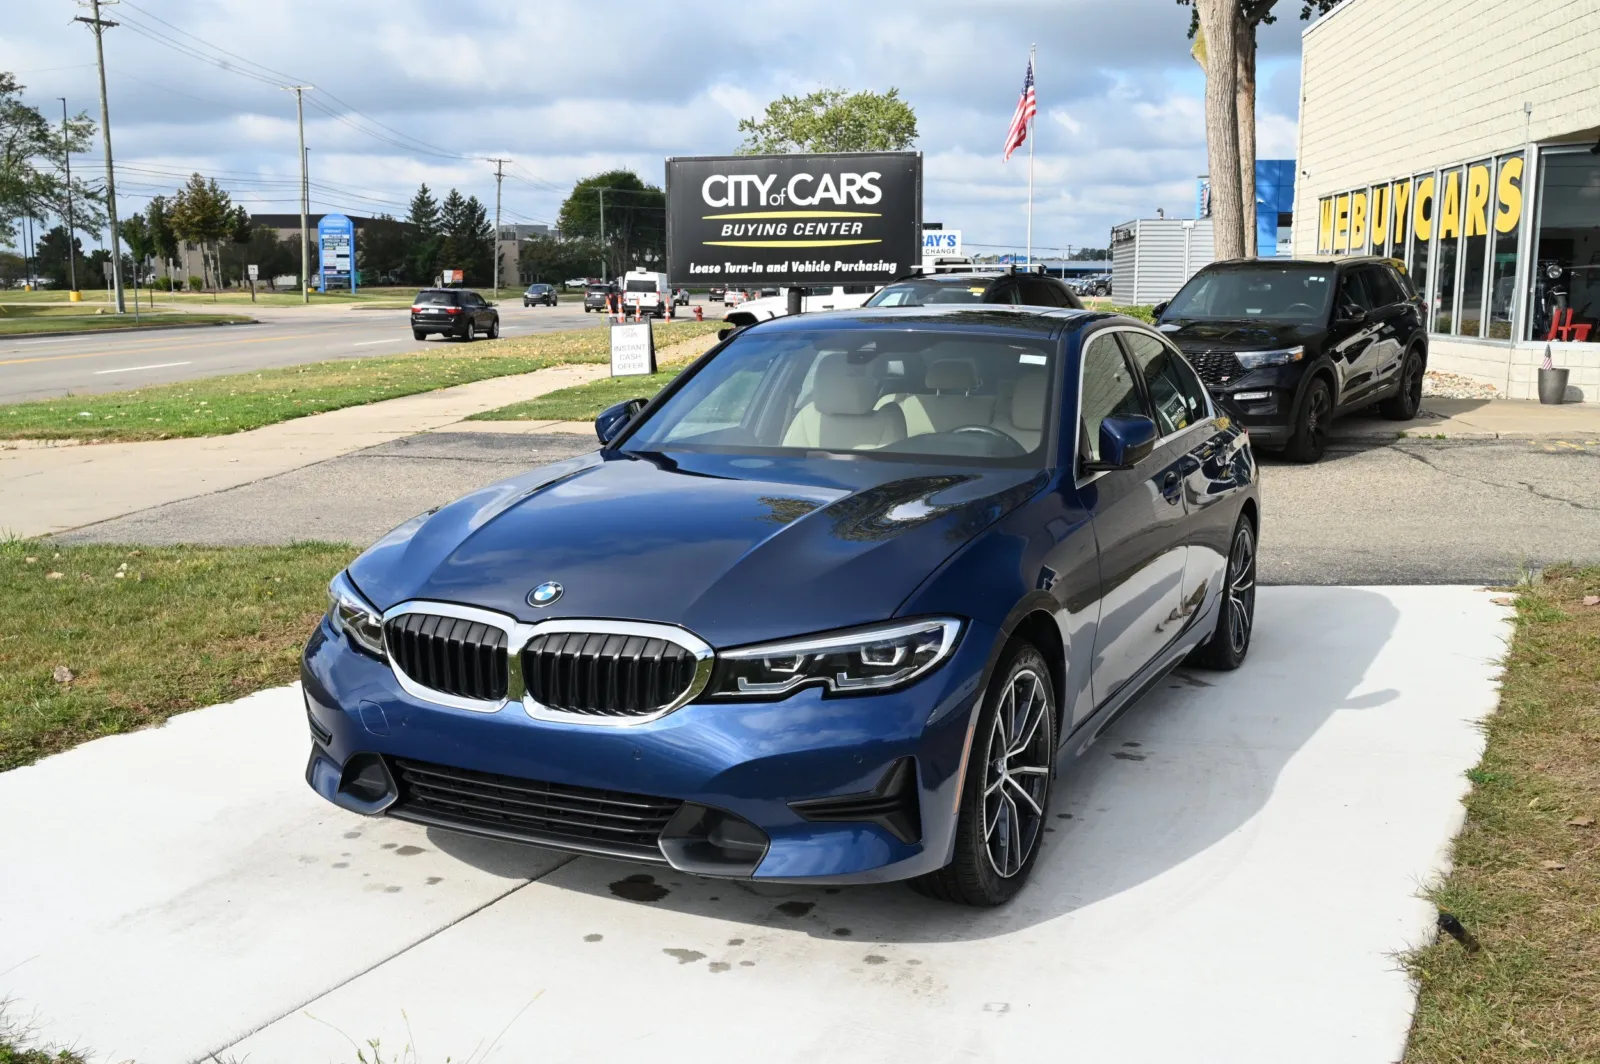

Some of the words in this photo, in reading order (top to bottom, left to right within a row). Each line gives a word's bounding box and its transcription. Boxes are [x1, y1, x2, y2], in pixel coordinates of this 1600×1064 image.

[702, 174, 777, 207] CITY
[769, 187, 788, 206] of
[787, 171, 882, 206] CARS
[721, 223, 788, 237] BUYING
[792, 222, 863, 236] CENTER
[690, 262, 721, 274] Lease
[724, 262, 763, 274] Turn-In
[766, 261, 788, 273] and
[791, 261, 831, 273] Vehicle
[834, 260, 897, 275] Purchasing
[614, 344, 645, 352] INSTANT
